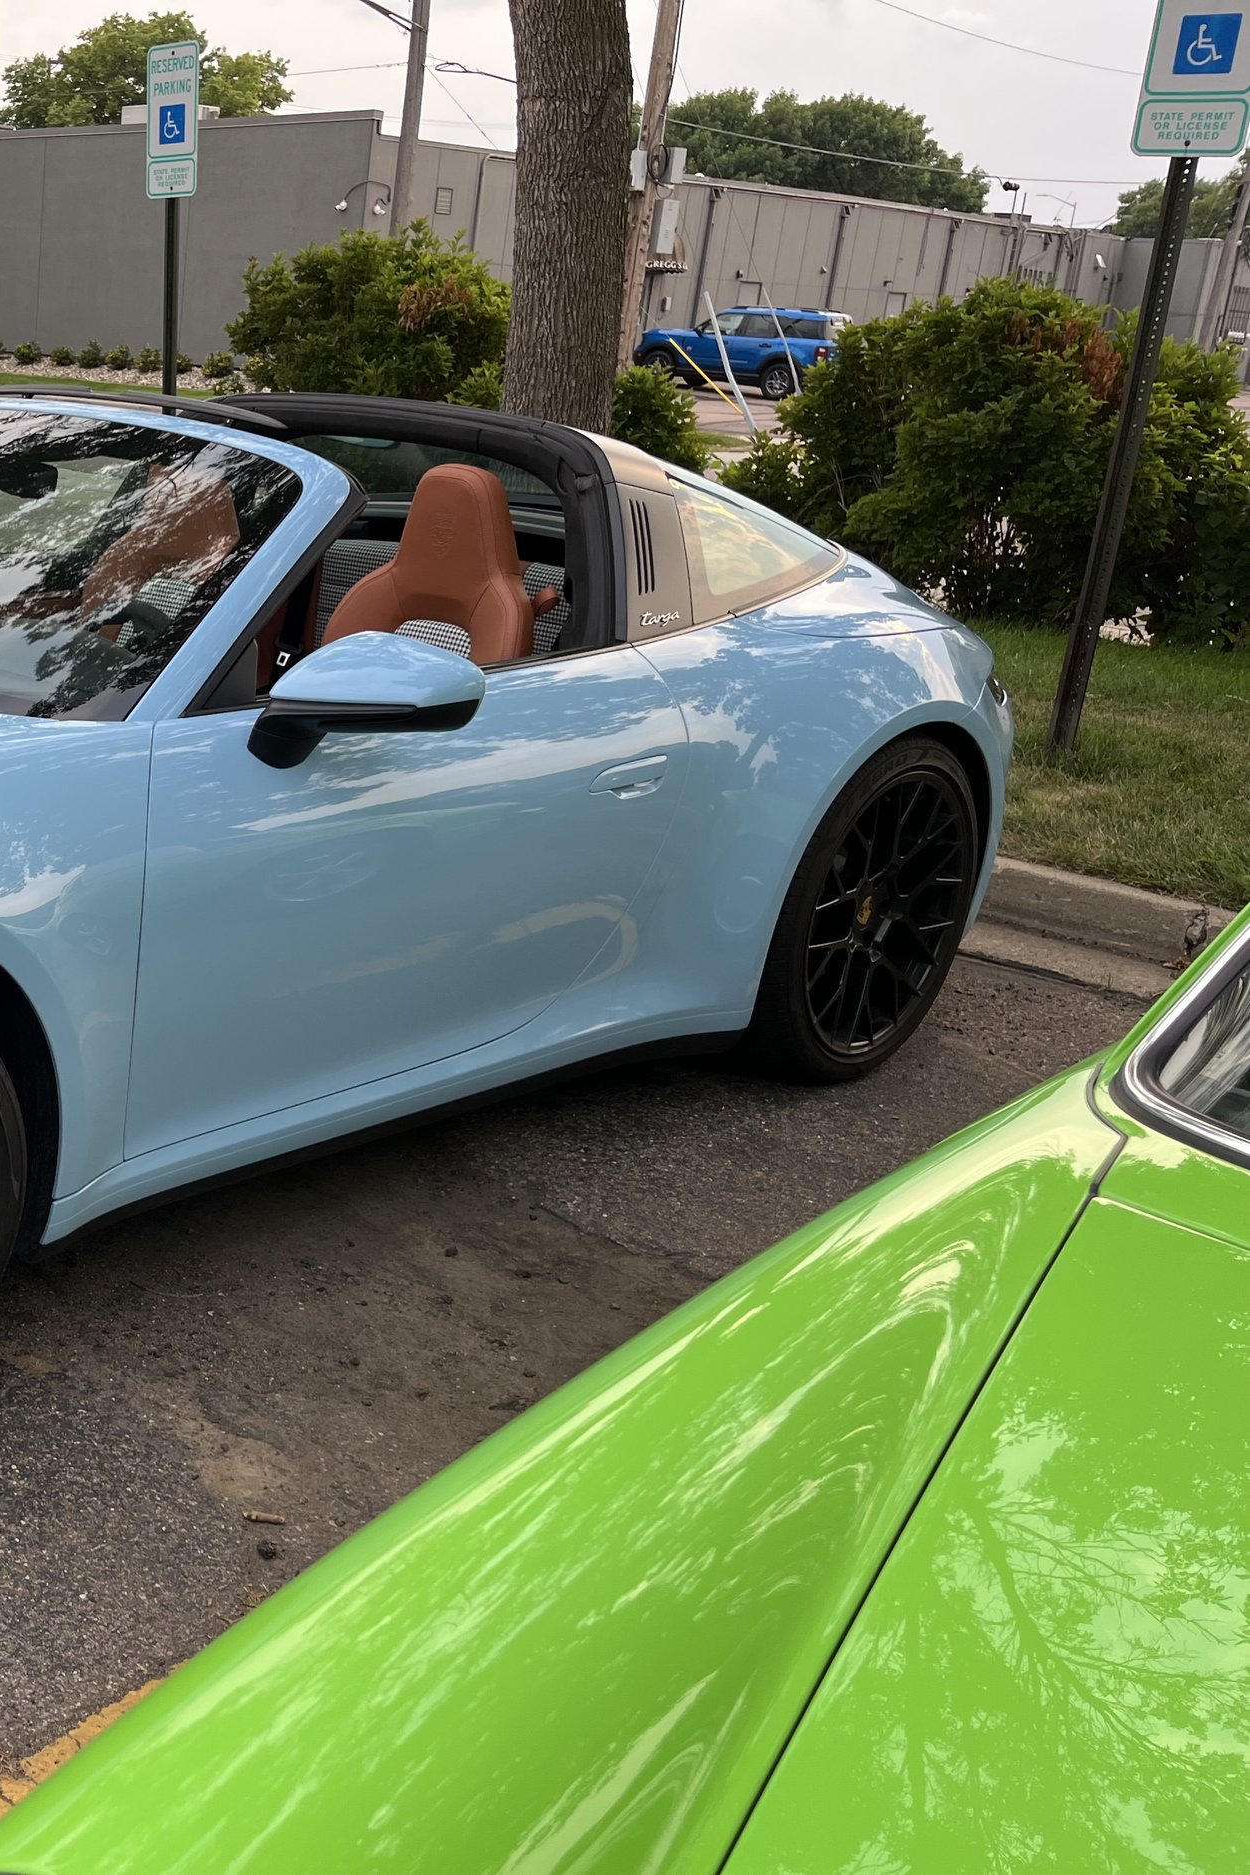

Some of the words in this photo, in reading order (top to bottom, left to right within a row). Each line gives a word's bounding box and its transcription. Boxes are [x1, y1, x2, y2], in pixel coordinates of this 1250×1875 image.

[151, 55, 195, 74] RESERVED
[153, 79, 191, 96] PARKING
[1151, 112, 1184, 120] STATE
[1190, 112, 1235, 120] PERMIT
[1154, 122, 1170, 130] OR
[1176, 121, 1228, 130] LICENSE
[1157, 131, 1220, 140] REQUIRED
[640, 611, 680, 627] targa
